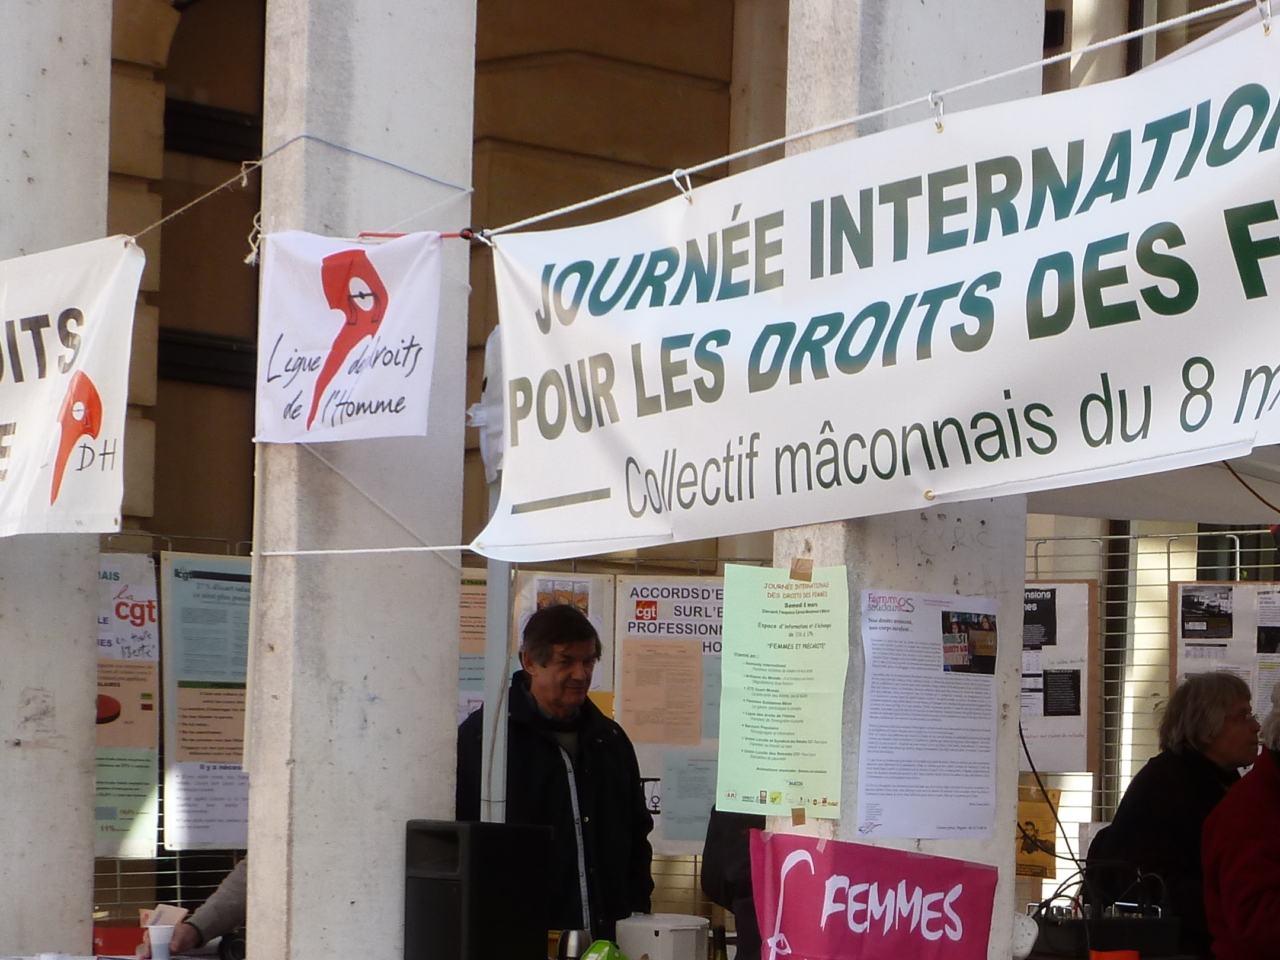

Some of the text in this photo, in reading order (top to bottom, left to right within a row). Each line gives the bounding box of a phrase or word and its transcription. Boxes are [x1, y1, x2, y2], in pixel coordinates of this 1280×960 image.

[535, 203, 784, 335] JOURNÉE
[0, 307, 84, 383] ITS
[267, 333, 321, 389] Ligue
[508, 351, 619, 447] POUR
[631, 328, 731, 418] LES
[748, 270, 1001, 394] DROITS
[1026, 221, 1200, 340] DES
[283, 390, 406, 427] de l'Homme
[624, 431, 761, 518] Collectif
[775, 389, 1058, 496] mâconnais
[1079, 372, 1151, 448] du
[1179, 356, 1216, 433] 8
[115, 600, 156, 627] cgt
[630, 587, 699, 599] ACCORDS
[636, 605, 657, 619] cgt
[674, 605, 702, 617] SUR
[820, 874, 963, 941] FEMMES
